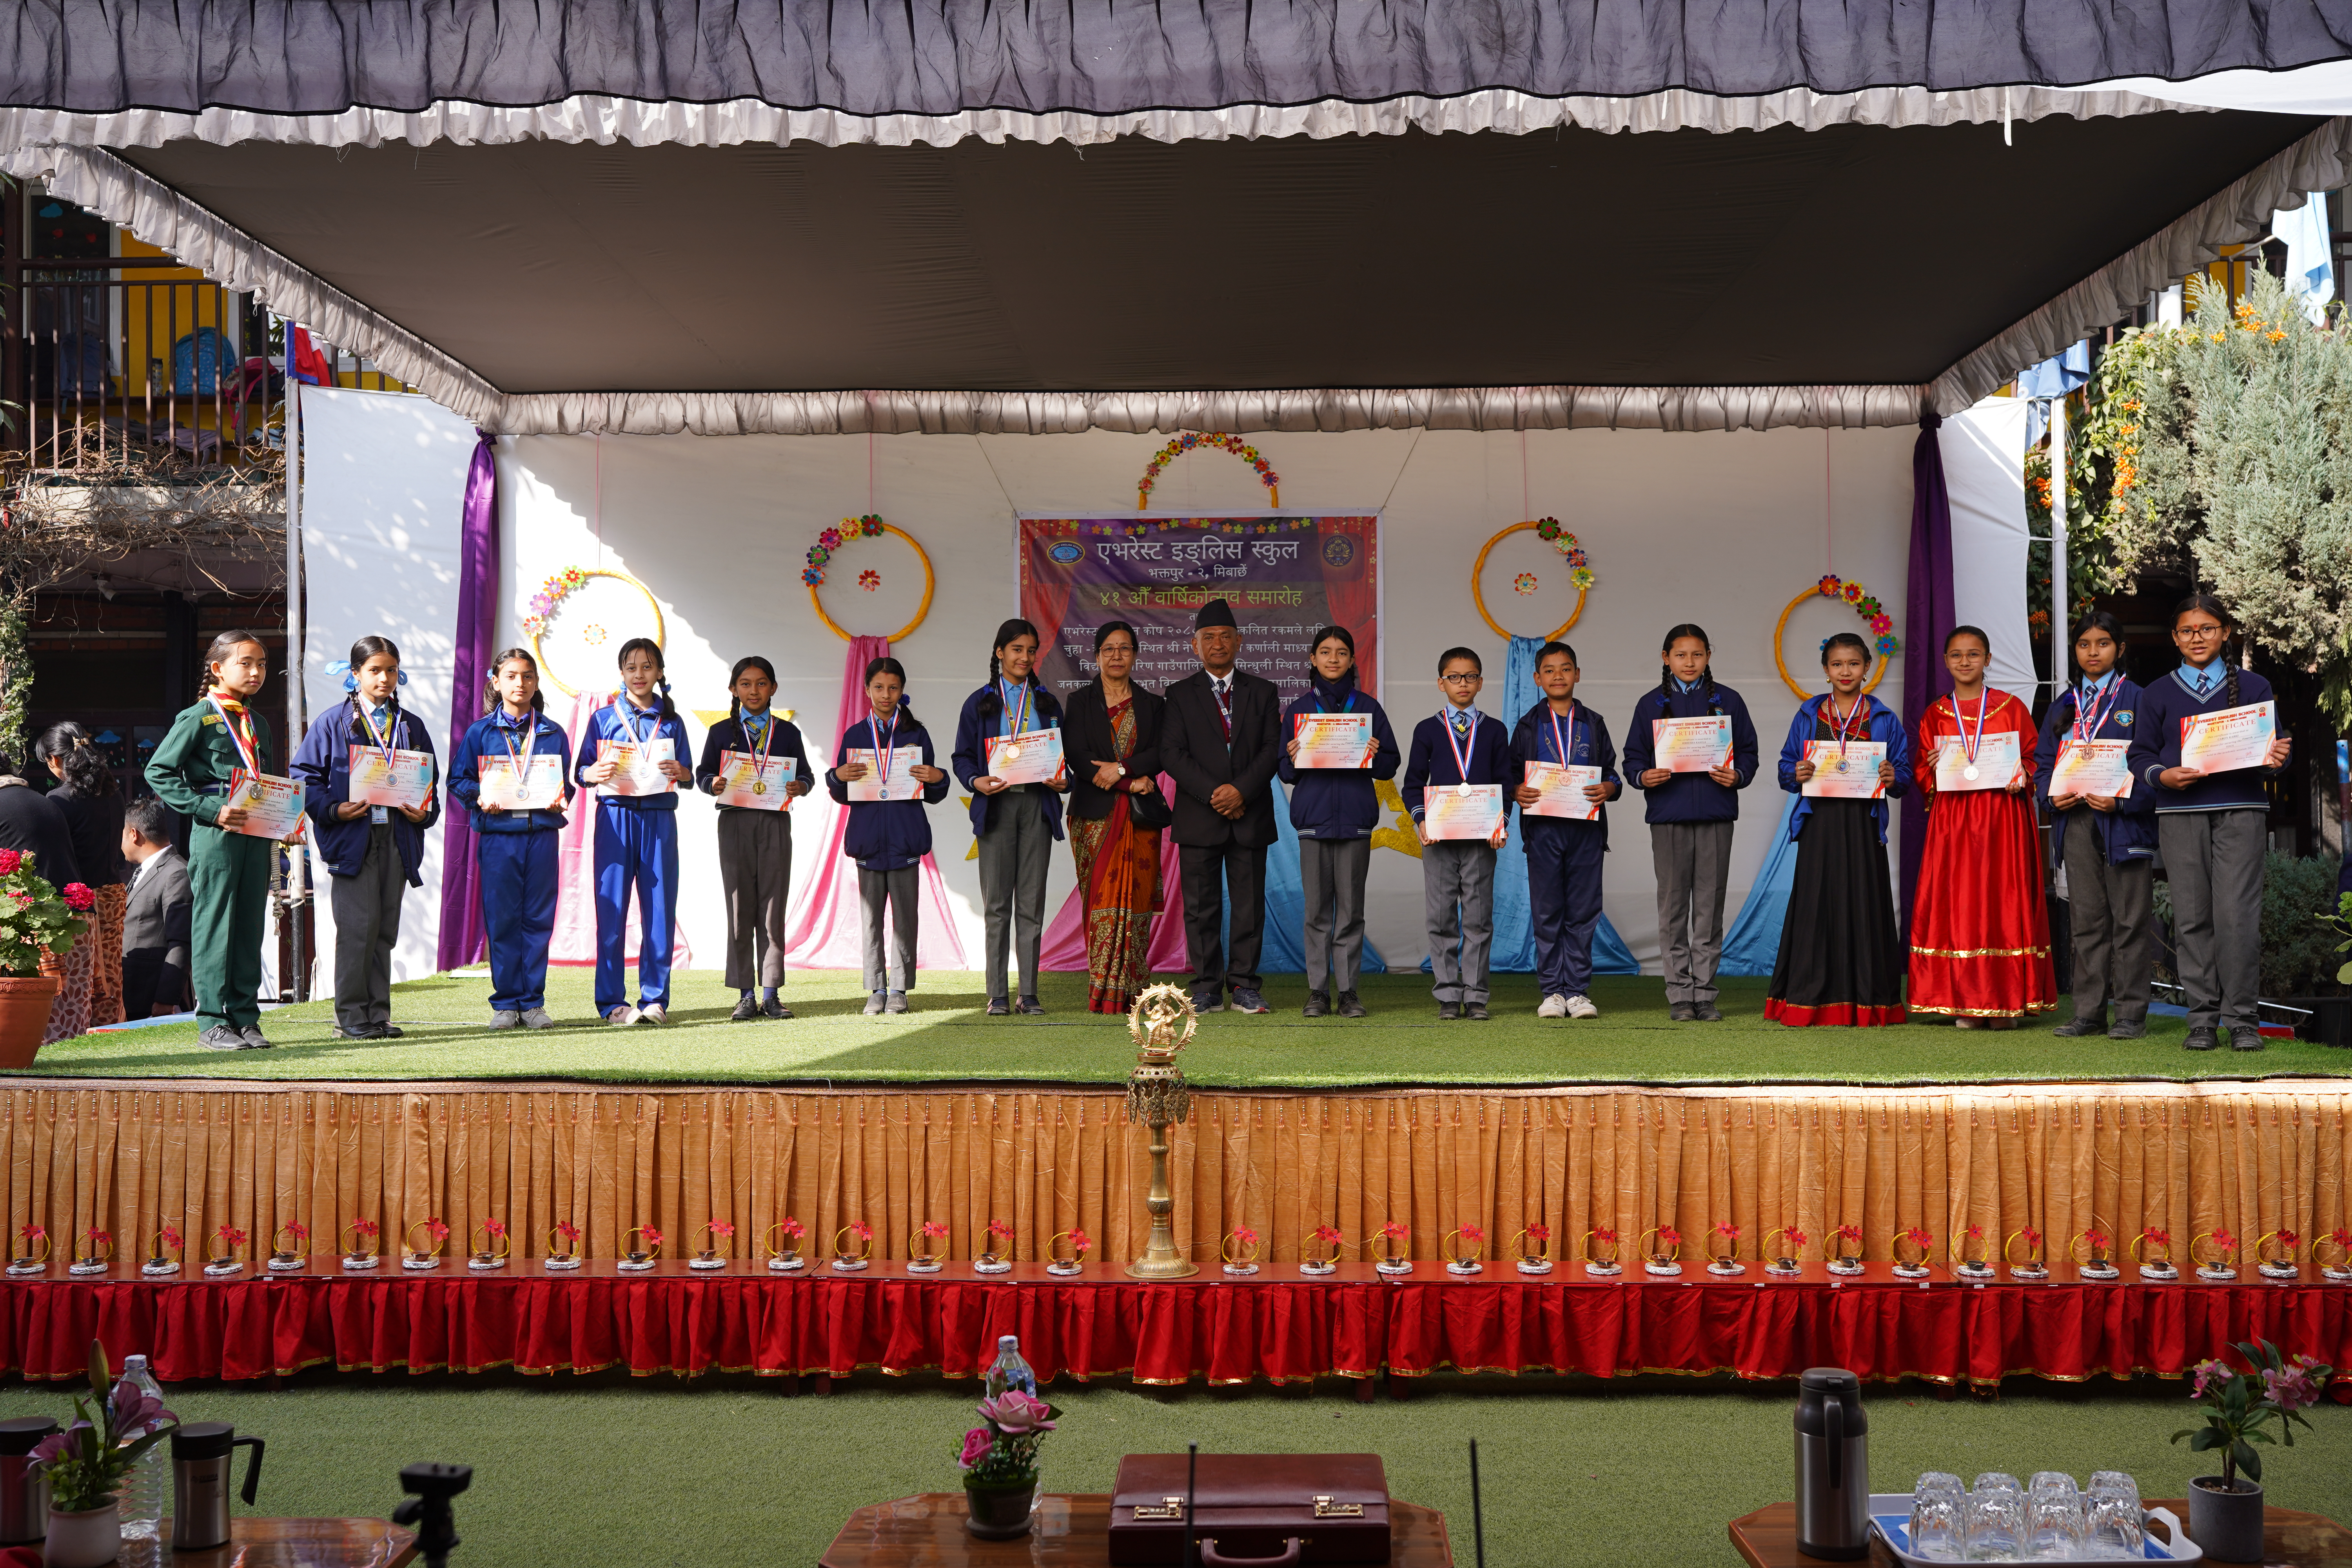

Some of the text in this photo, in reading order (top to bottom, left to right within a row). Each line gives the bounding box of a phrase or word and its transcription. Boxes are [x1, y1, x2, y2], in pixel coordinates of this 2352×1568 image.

[1096, 535, 1299, 566] एभरेस्ट इङ्लिस स्कुल
[1149, 568, 1184, 582] भक्तपुर
[1213, 564, 1247, 577] मिबाछें
[1100, 592, 1120, 606] ४१
[1247, 586, 1303, 607] समारोह
[1143, 623, 1163, 635] कोष
[1271, 623, 1303, 635] रकमले
[1063, 645, 1083, 657] चुहा
[1138, 641, 1164, 653] स्थित
[1167, 641, 1180, 653] श्री
[1246, 641, 1280, 653] कर्णाली
[1235, 658, 1272, 673] सिन्धुली
[1276, 658, 1301, 670] स्थित
[2199, 719, 2256, 734] CERTIFICATE
[367, 760, 418, 771] CERTICATE
[246, 787, 290, 799] CIFICATE
